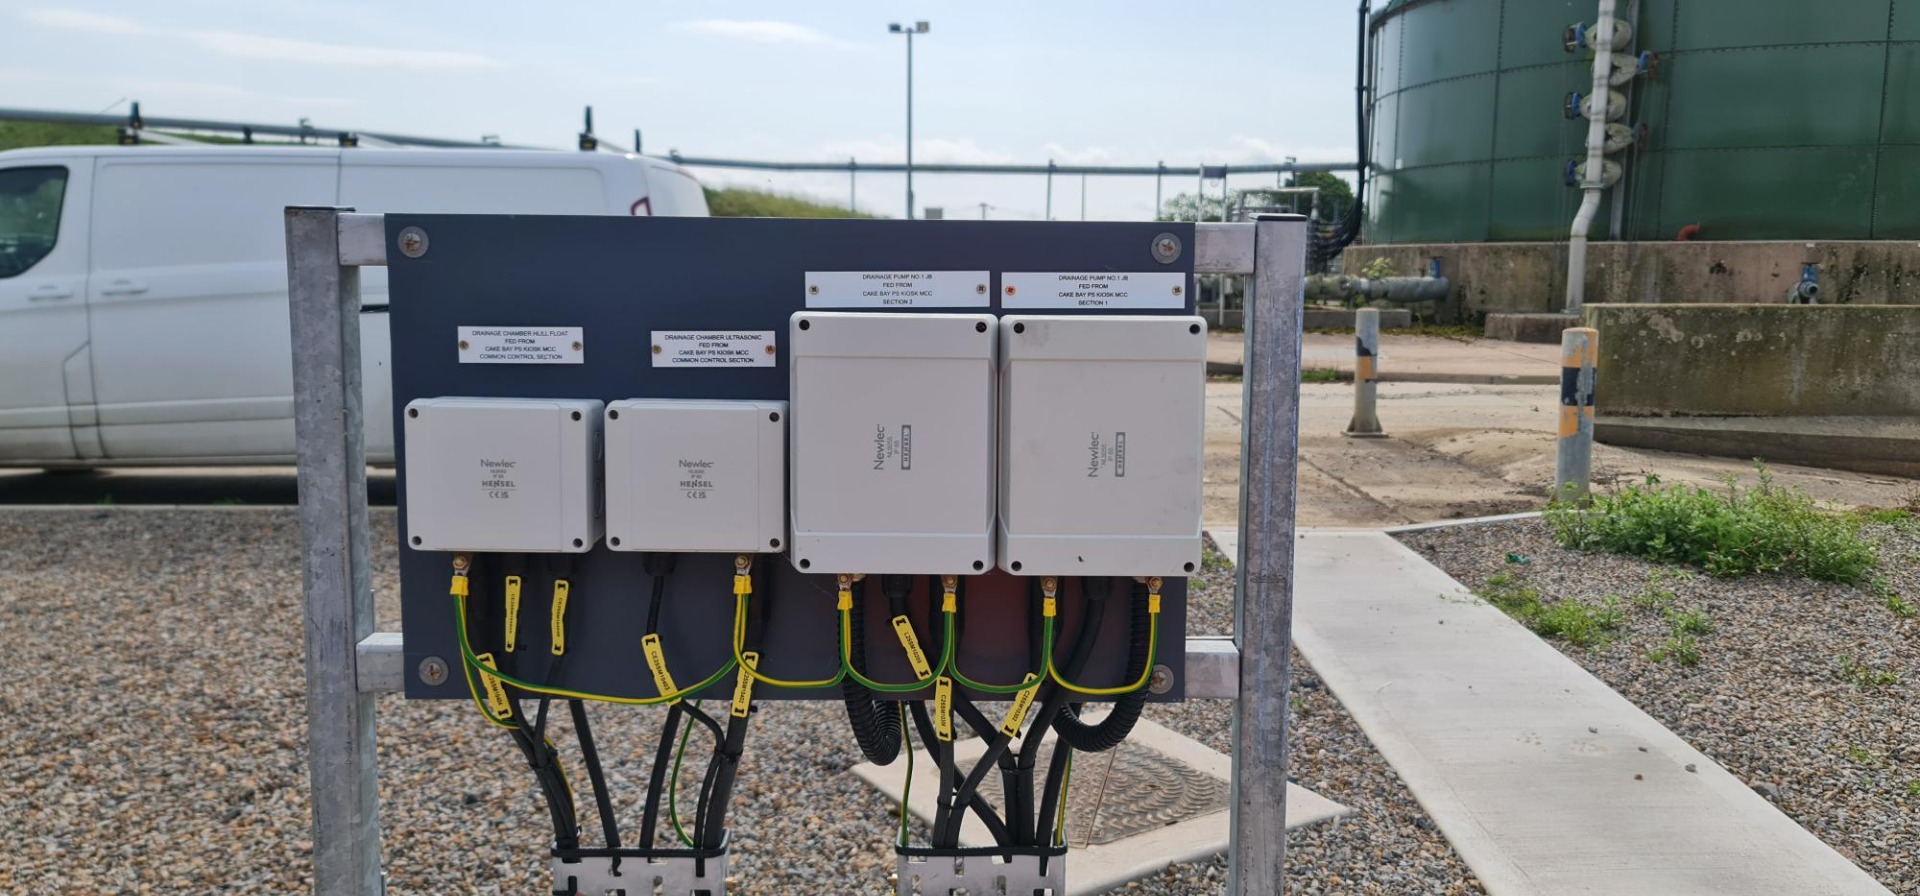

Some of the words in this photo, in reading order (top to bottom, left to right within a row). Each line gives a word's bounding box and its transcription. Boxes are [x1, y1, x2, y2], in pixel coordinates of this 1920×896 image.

[873, 424, 884, 470] Newlec
[1087, 432, 1099, 477] Newlec
[481, 459, 517, 468] Newlec
[679, 459, 714, 468] Newlec
